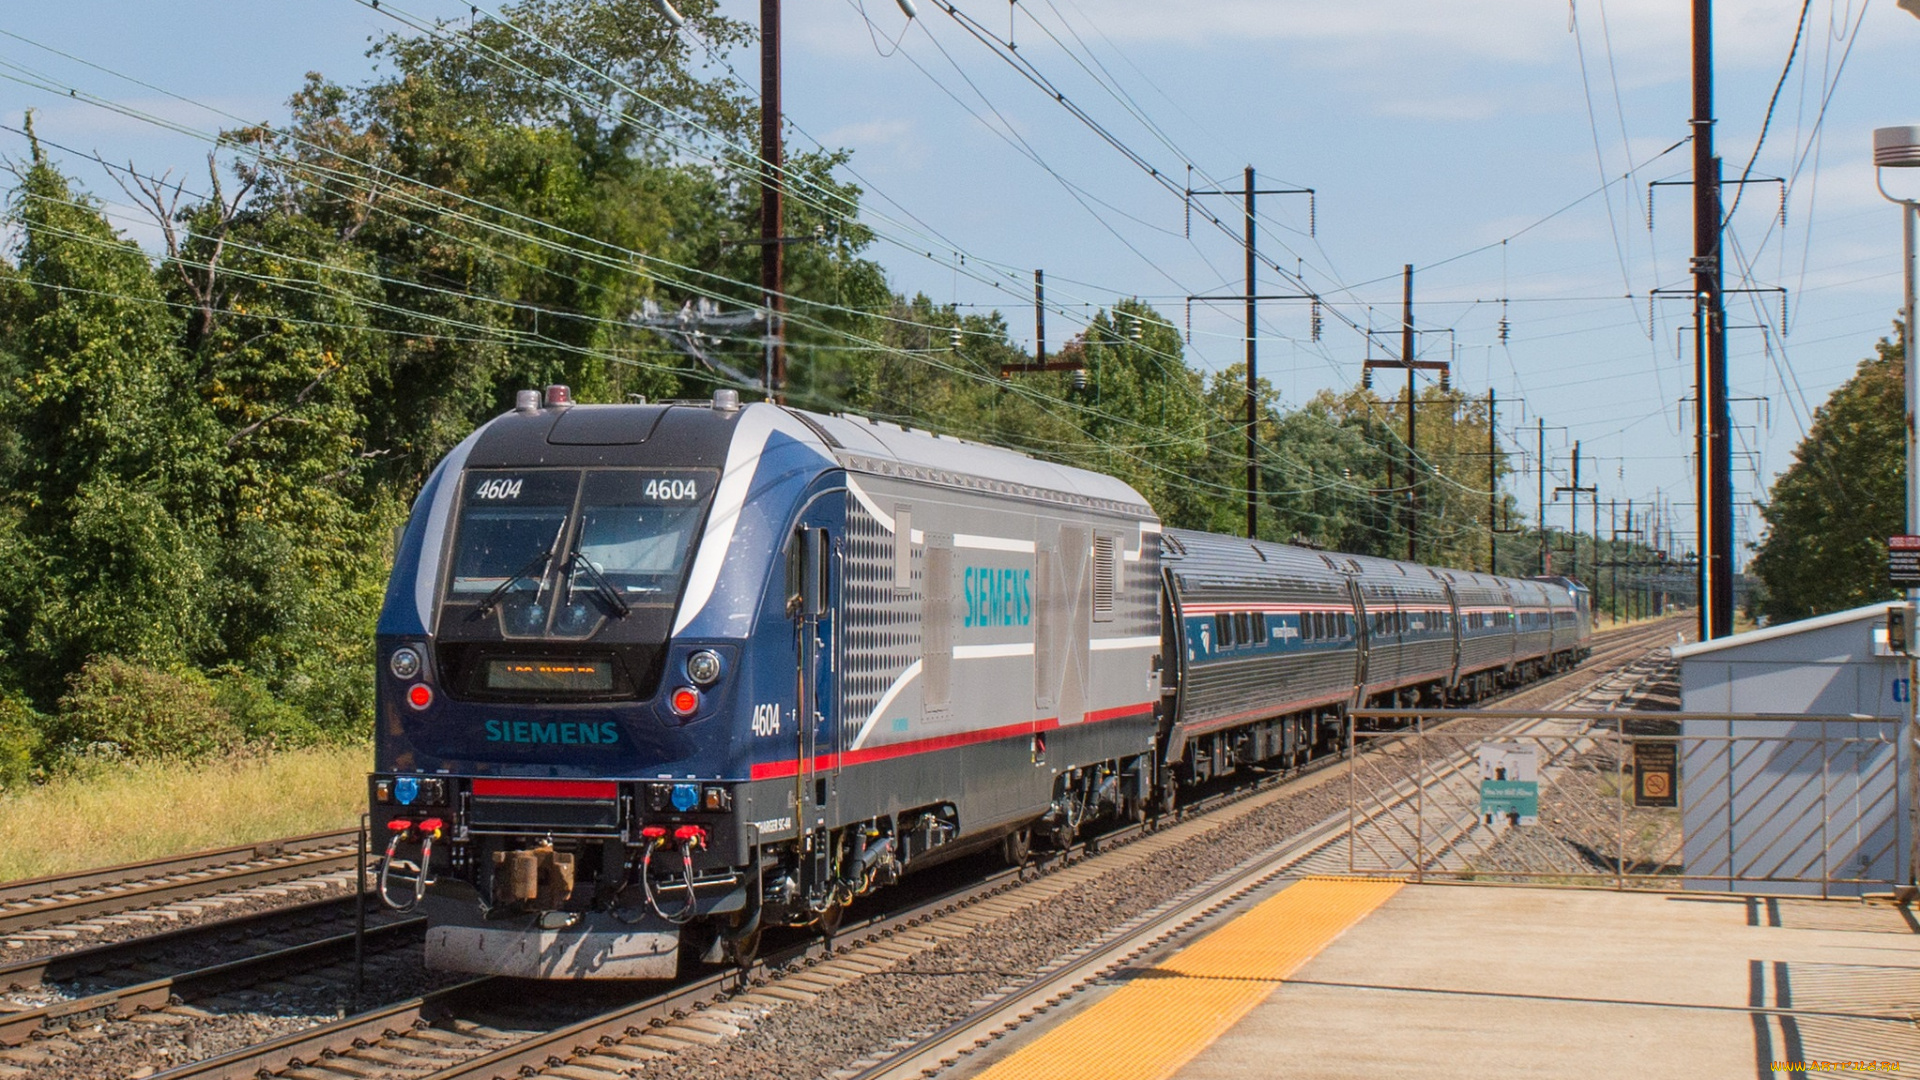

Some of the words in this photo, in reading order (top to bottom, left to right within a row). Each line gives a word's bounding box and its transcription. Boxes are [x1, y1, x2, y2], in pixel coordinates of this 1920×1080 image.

[476, 478, 523, 499] 4604
[645, 479, 697, 500] 4604
[964, 566, 1030, 627] SIEMENS
[484, 719, 619, 744] SIEMENS
[751, 703, 780, 737] 4604
